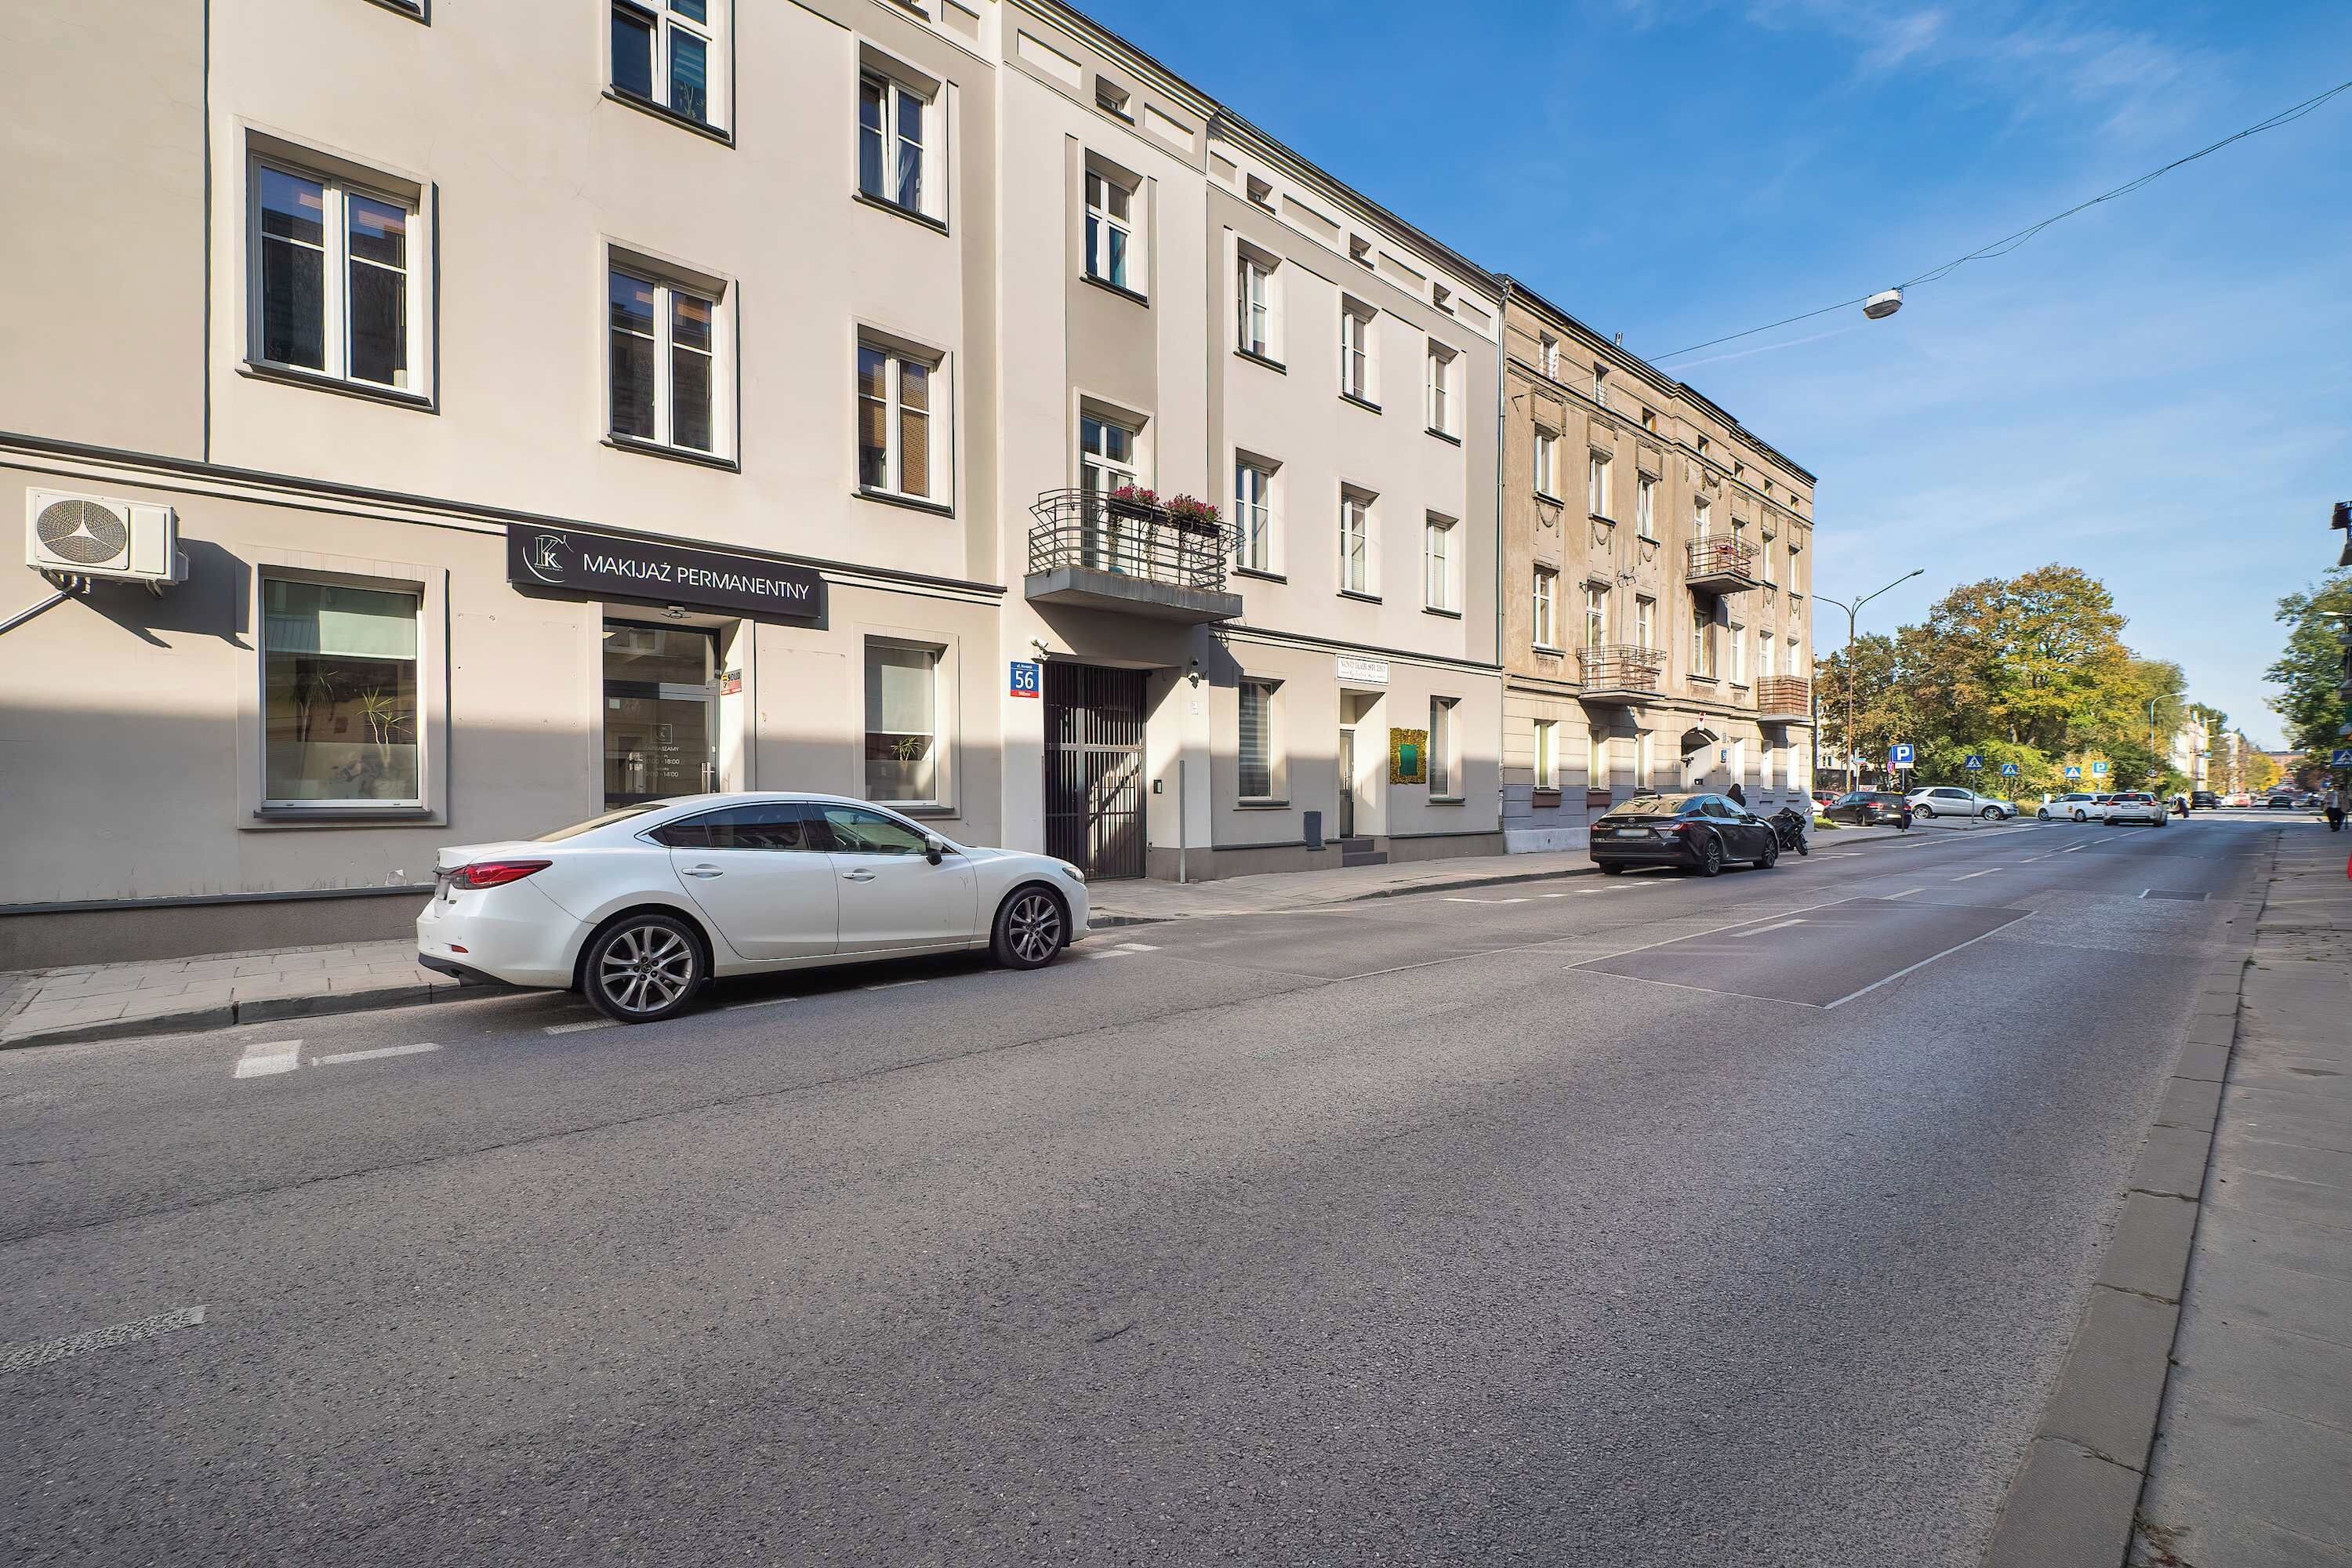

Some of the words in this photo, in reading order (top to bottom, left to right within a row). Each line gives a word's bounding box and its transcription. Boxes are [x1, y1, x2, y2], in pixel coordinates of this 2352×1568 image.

[583, 553, 672, 583] MAKIJAŻ
[677, 568, 809, 600] PERMANENTNY
[1015, 670, 1034, 690] 56
[1897, 746, 1910, 760] P
